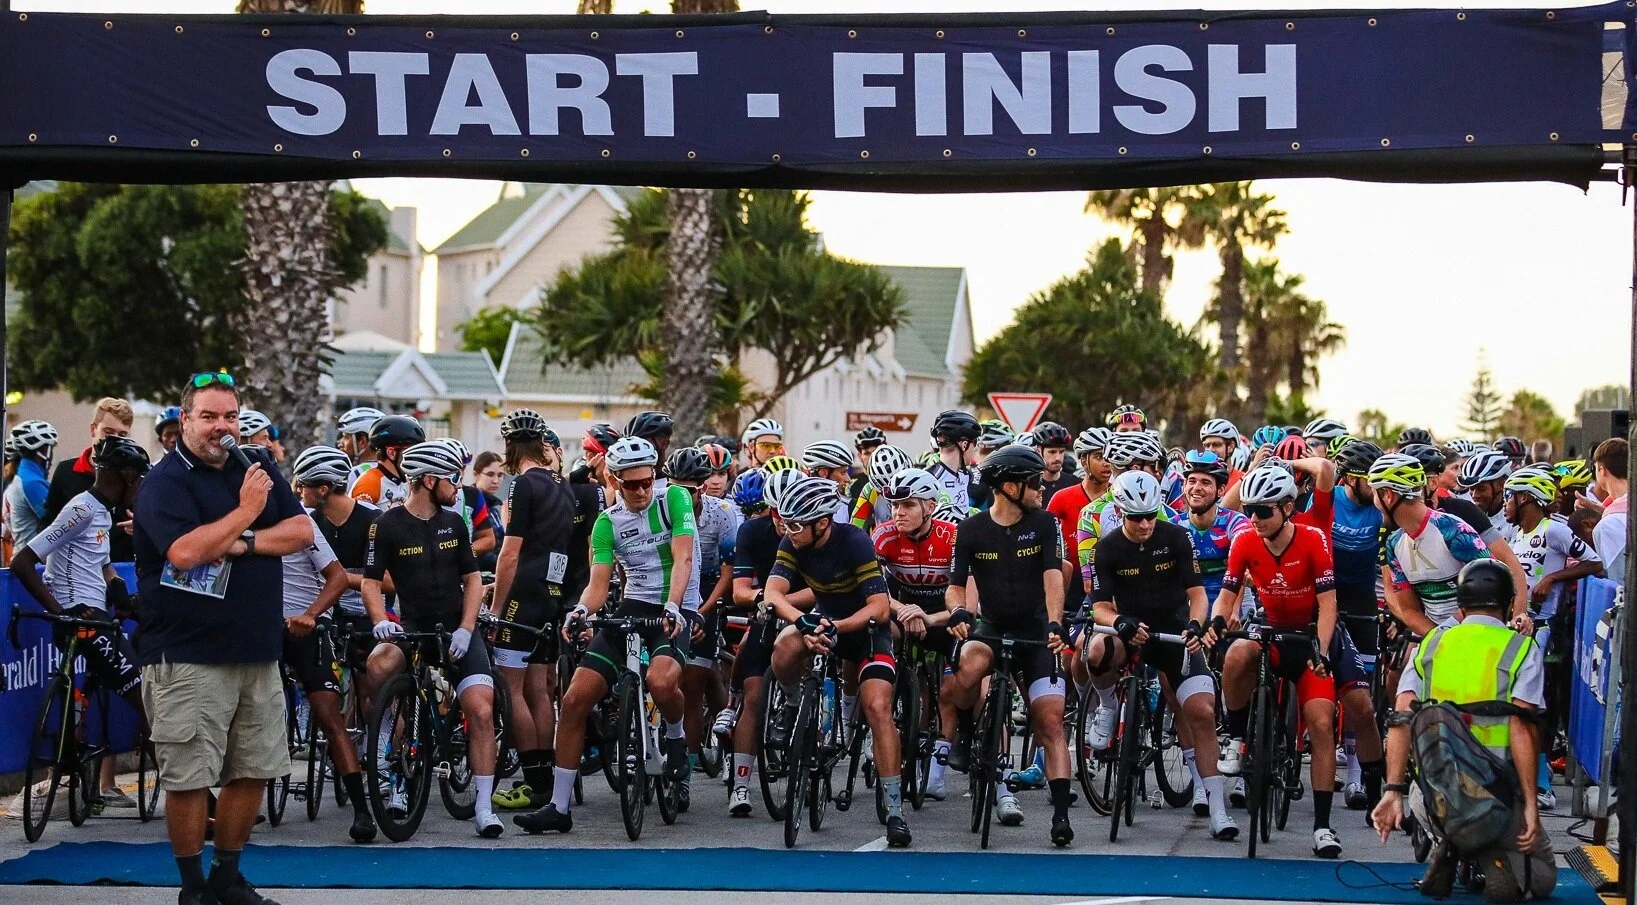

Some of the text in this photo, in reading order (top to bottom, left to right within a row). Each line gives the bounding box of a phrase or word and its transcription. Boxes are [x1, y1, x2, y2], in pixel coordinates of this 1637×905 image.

[266, 49, 698, 136] START
[833, 43, 1297, 138] FINISH
[398, 546, 424, 556] ACTION
[974, 552, 998, 560] ACTION
